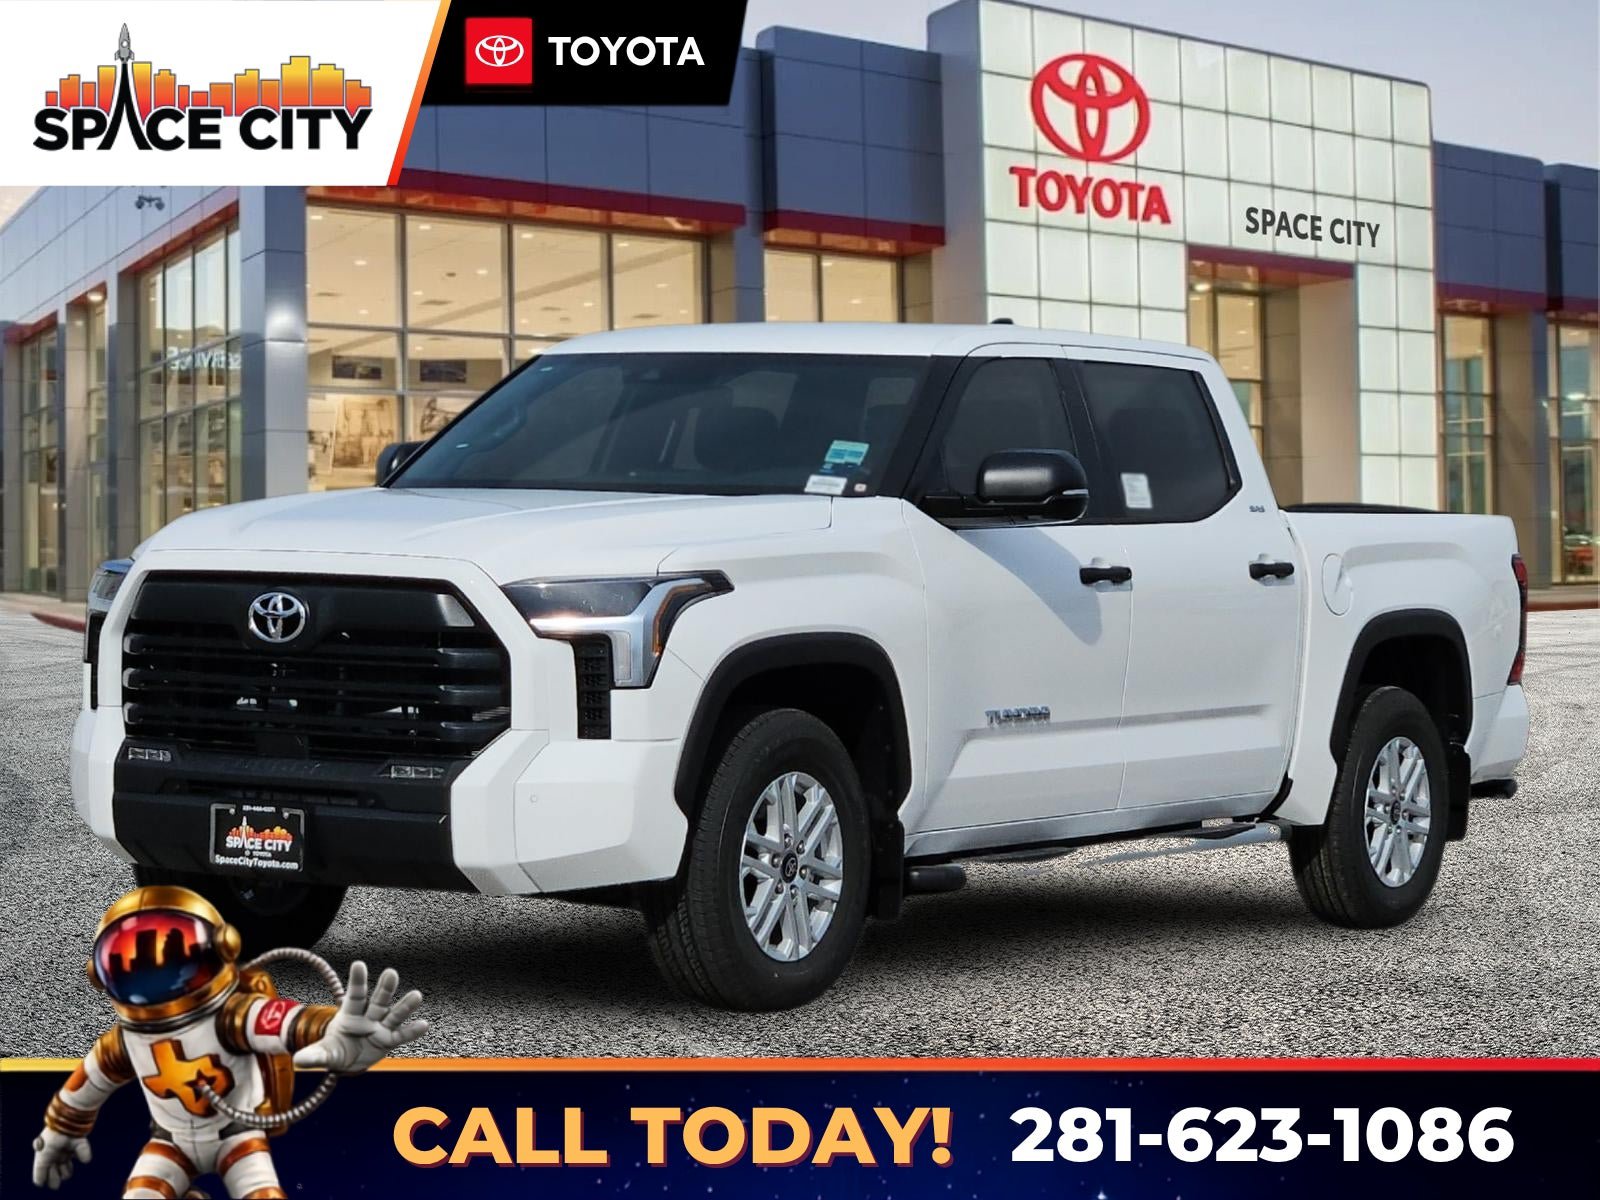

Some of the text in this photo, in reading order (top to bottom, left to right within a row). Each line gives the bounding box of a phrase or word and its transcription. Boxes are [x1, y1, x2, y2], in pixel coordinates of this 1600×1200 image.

[1009, 166, 1171, 224] TOYOTA
[1245, 206, 1381, 248] SPACE CITY
[225, 835, 293, 852] SPACE CITY
[214, 854, 300, 870] SpaceCityToyota.com
